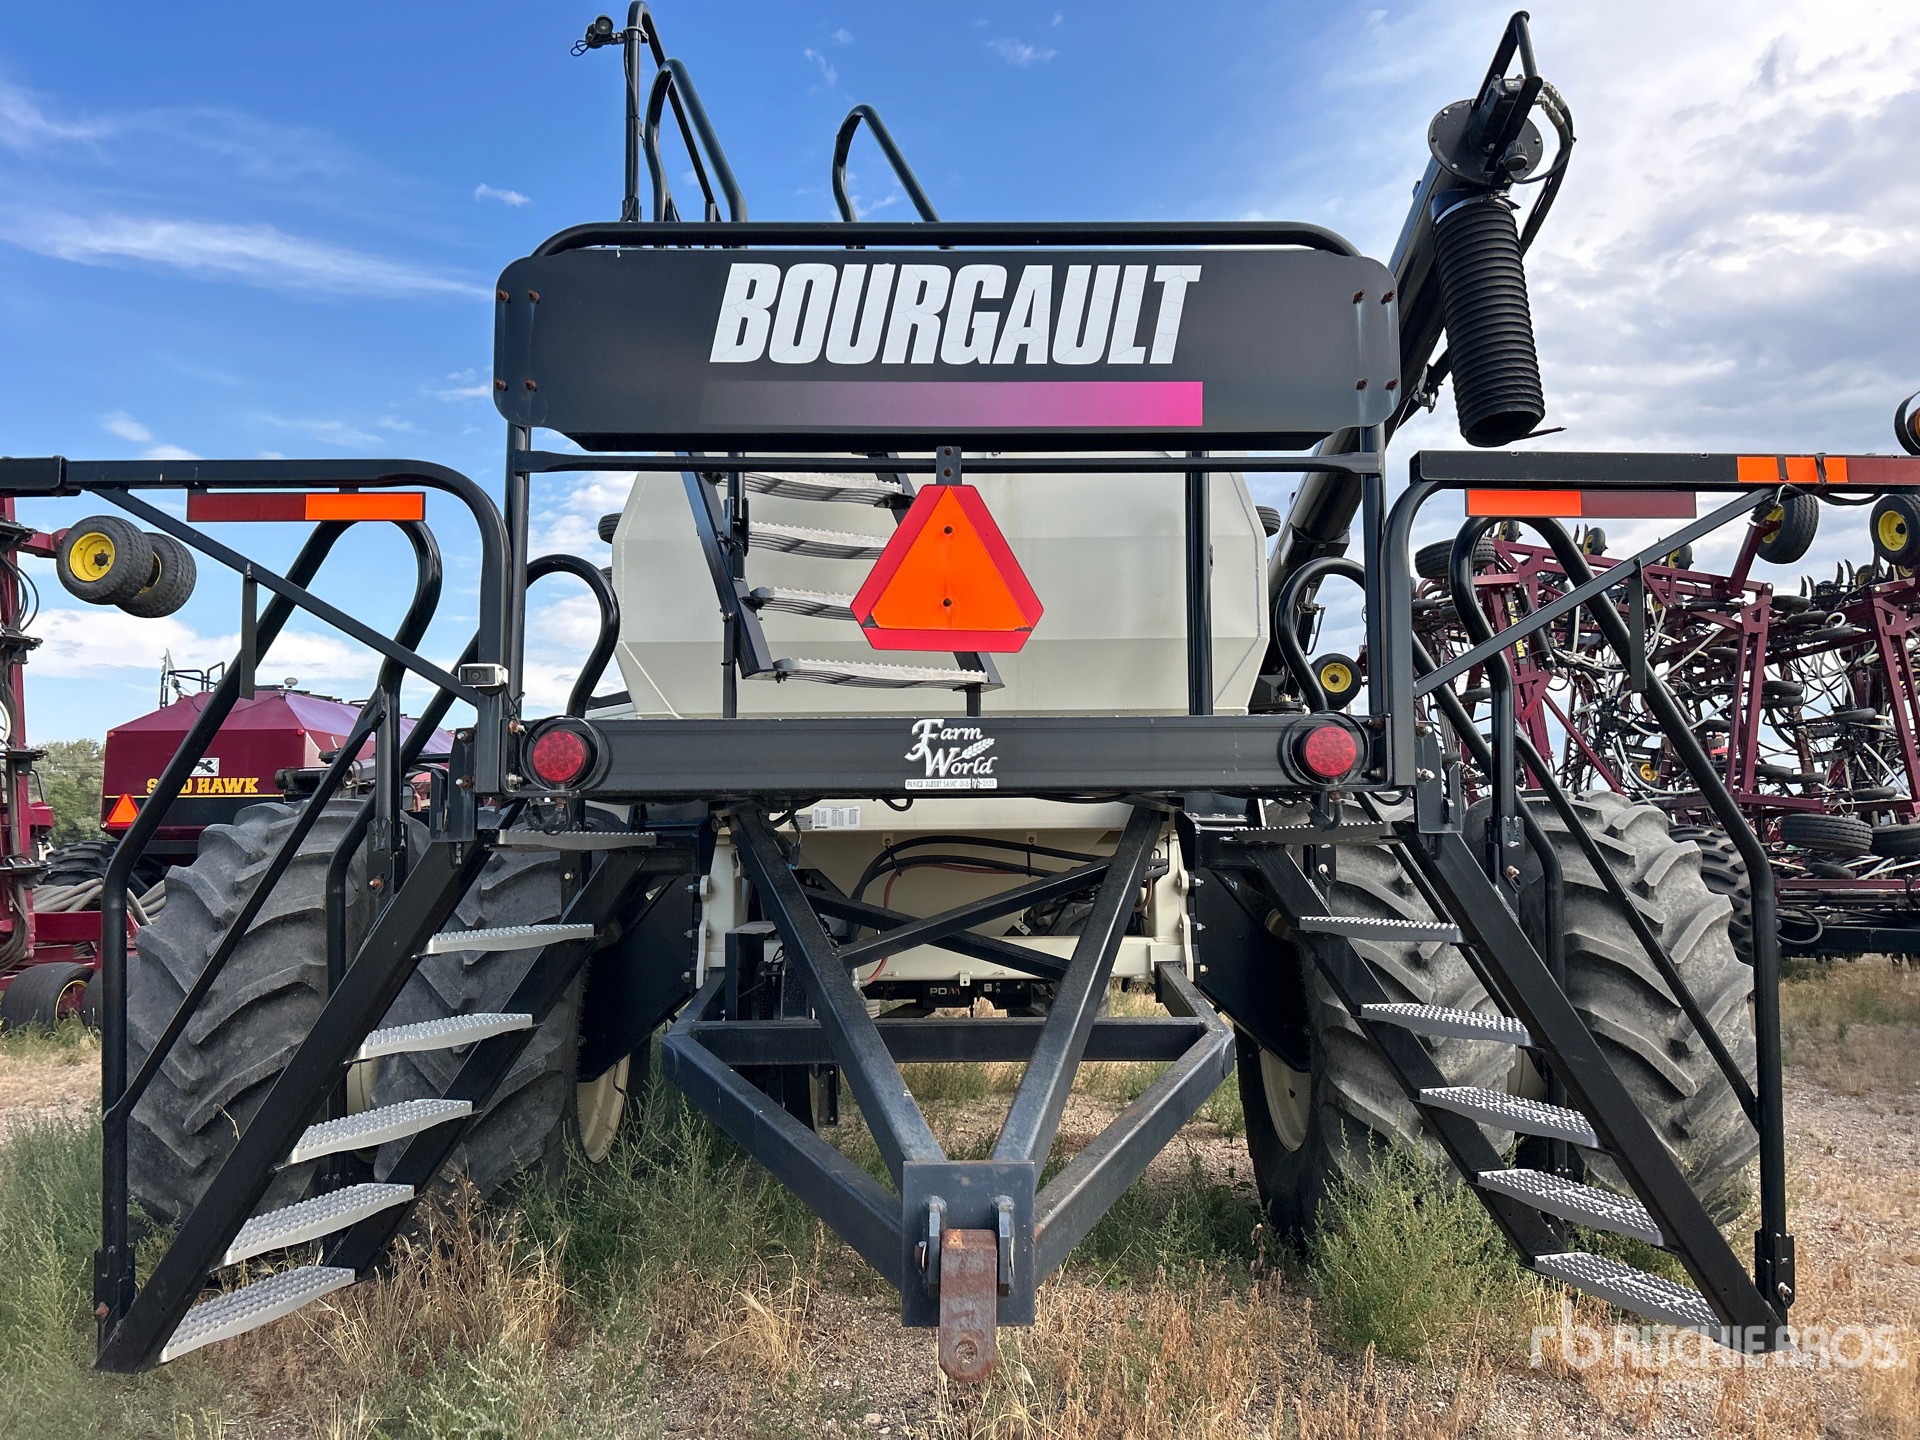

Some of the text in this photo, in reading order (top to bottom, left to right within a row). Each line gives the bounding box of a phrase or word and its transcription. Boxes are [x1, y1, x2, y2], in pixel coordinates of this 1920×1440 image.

[709, 262, 1203, 365] BOURGAULT
[904, 718, 983, 762] Farm
[912, 743, 999, 778] World
[146, 778, 259, 794] SD HAWK
[906, 780, 924, 788] PRINCE
